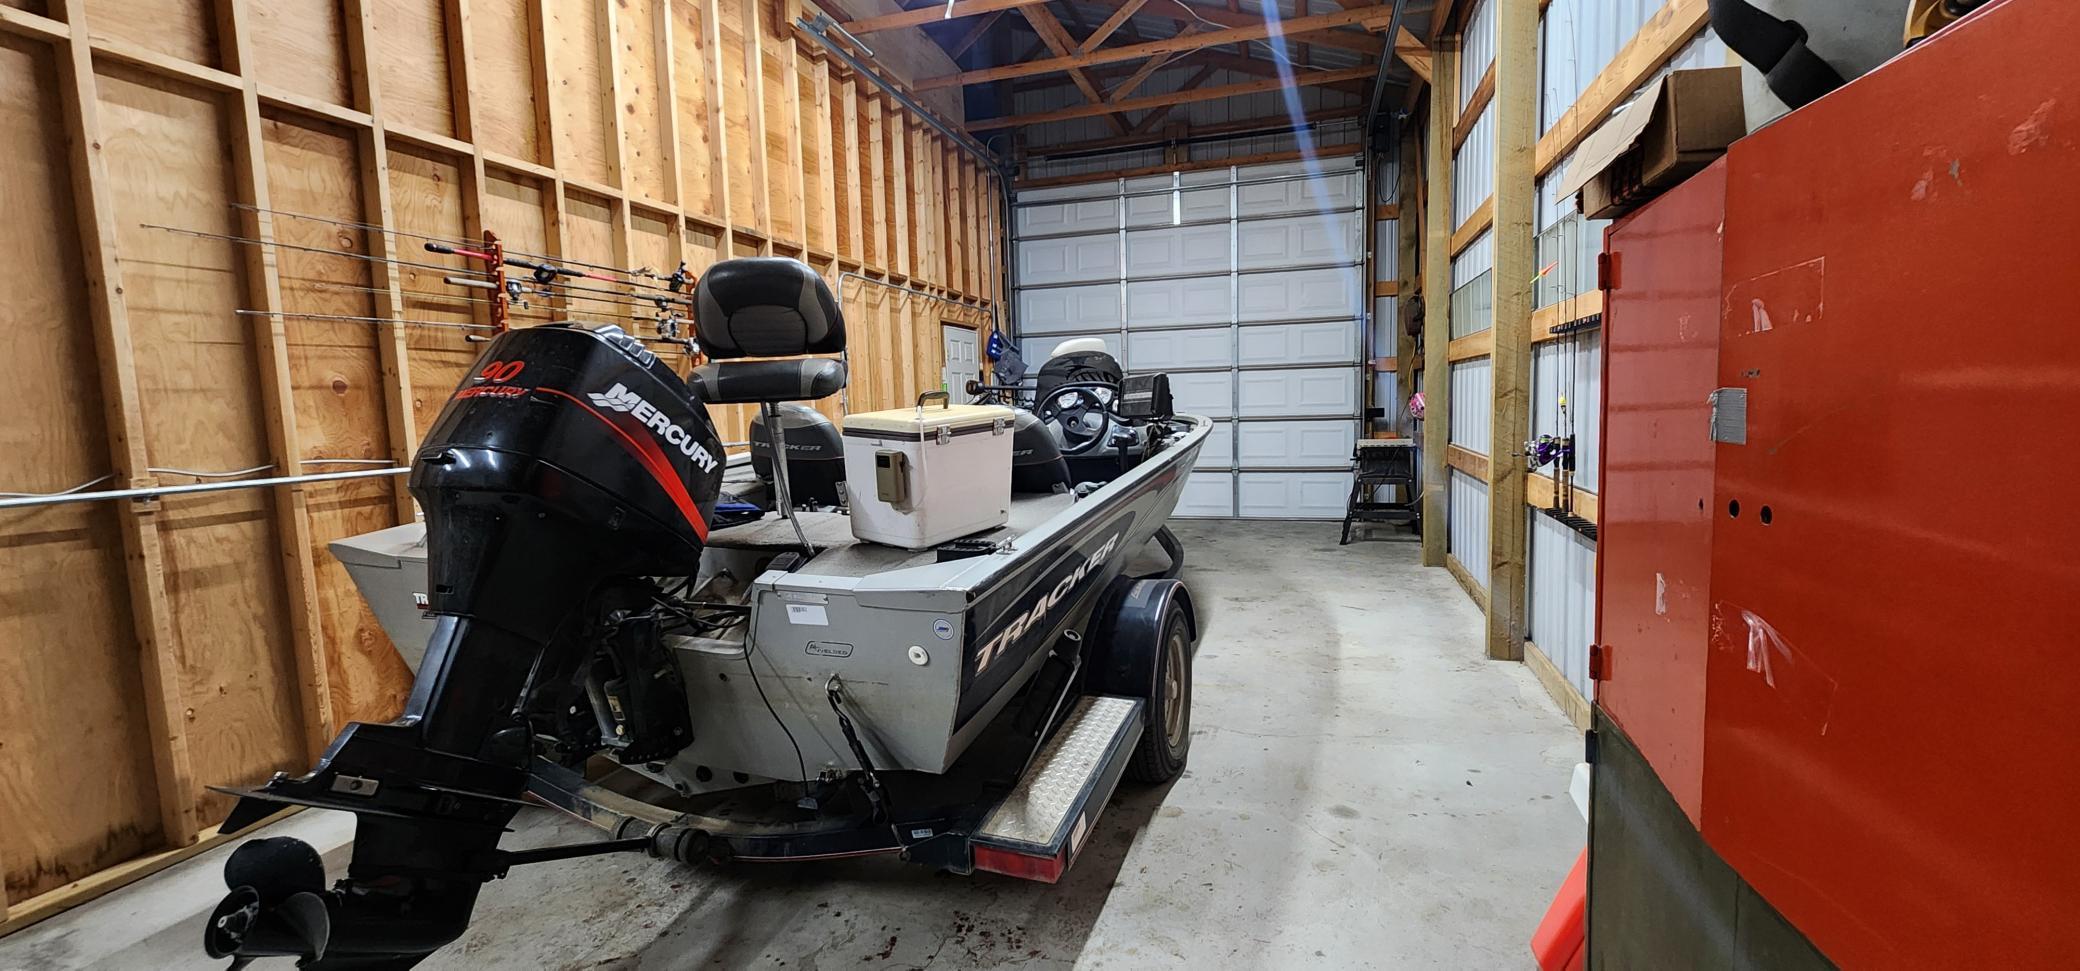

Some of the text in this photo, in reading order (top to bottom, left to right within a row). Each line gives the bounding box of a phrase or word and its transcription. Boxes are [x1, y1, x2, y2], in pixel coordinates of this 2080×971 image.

[474, 361, 525, 383] 90
[454, 386, 531, 400] MERCURY
[603, 382, 719, 474] MERCURY
[753, 440, 822, 451] TRCKER
[975, 532, 1120, 677] TRACKER
